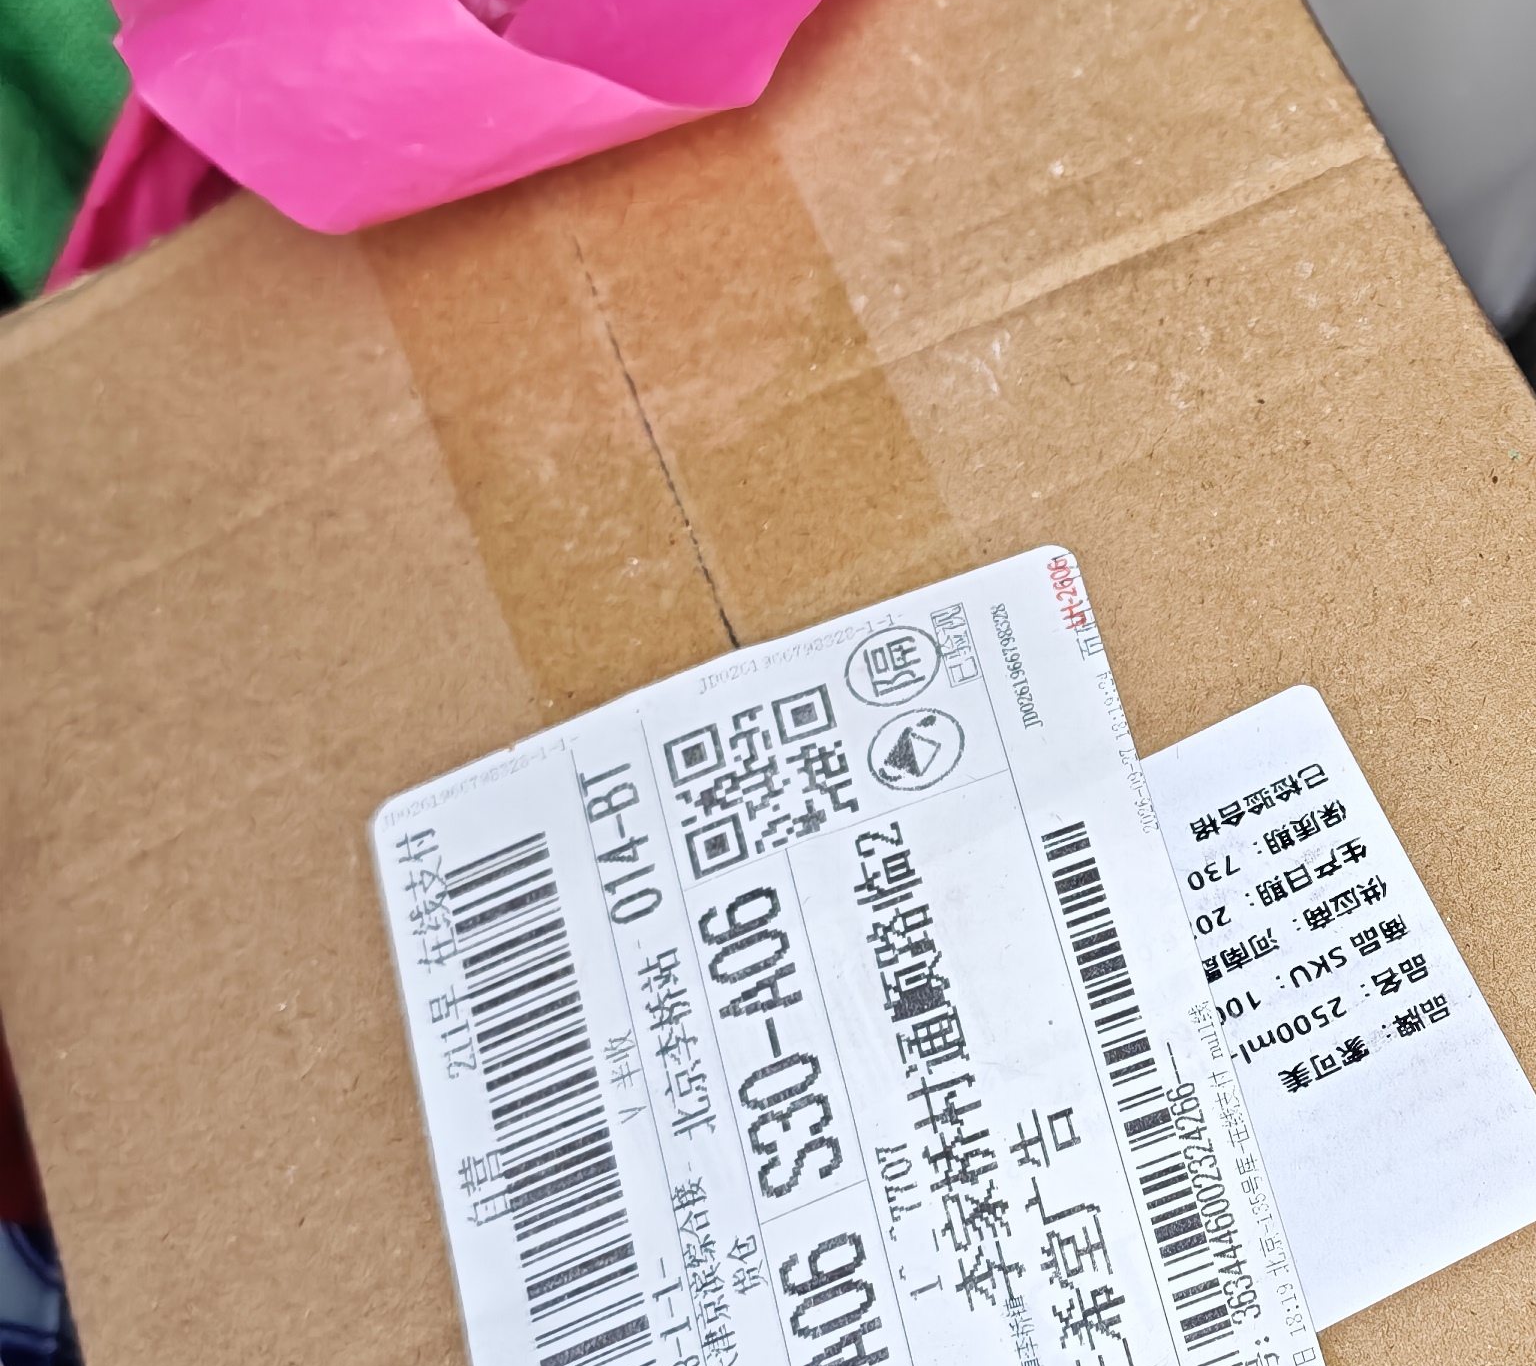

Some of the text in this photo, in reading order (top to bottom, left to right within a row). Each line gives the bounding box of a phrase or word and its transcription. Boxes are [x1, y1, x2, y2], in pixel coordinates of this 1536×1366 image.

[862, 631, 926, 699] 隔
[931, 603, 980, 685] 已验视
[578, 754, 664, 929] 014-BT
[1186, 761, 1329, 843] 已检验合格
[394, 821, 461, 977] 在线支付
[695, 881, 845, 1203] S30-A06
[457, 1145, 510, 1228] 自营
[722, 1229, 768, 1297] 货仓
[1274, 1280, 1307, 1337] 18:19
